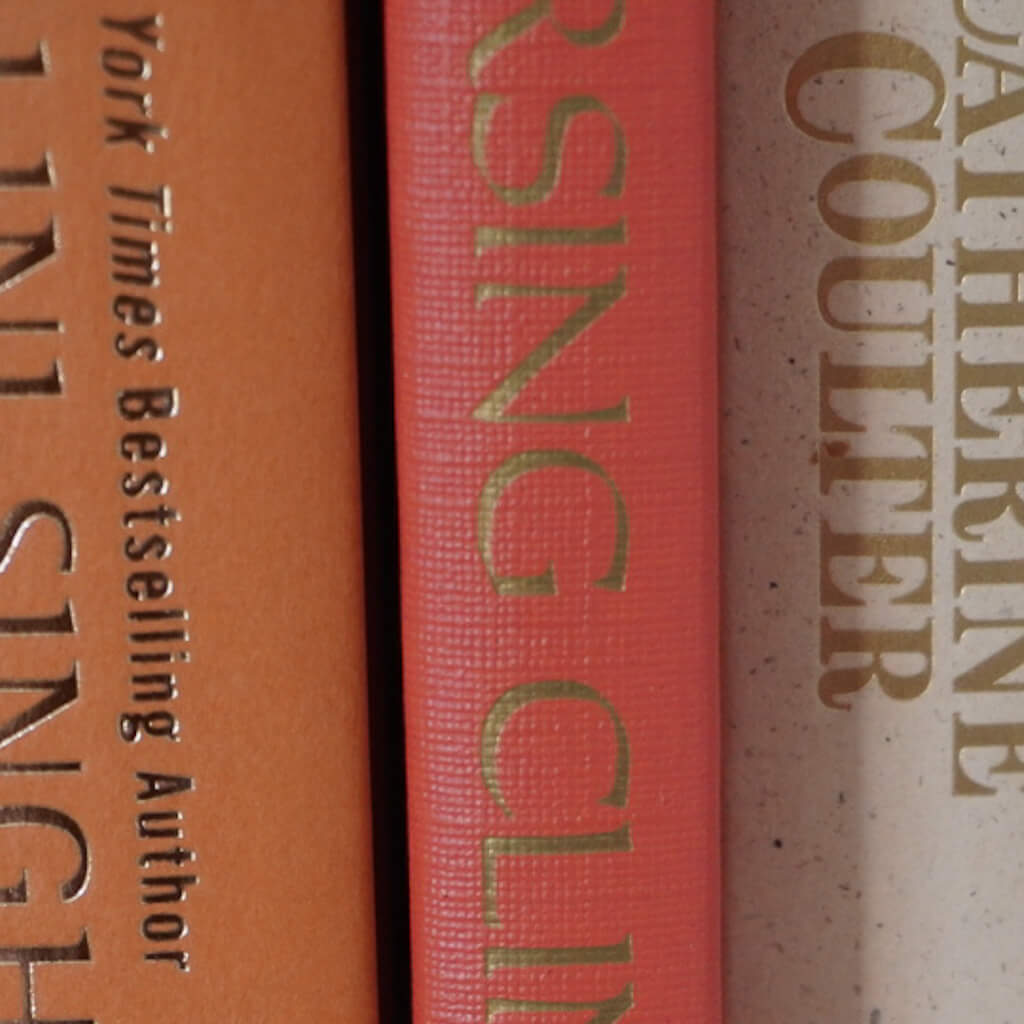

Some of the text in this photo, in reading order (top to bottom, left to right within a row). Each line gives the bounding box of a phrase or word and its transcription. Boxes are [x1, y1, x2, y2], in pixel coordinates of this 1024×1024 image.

[101, 12, 199, 973] York Times Bestselling Author
[784, 31, 948, 711] COULTER
